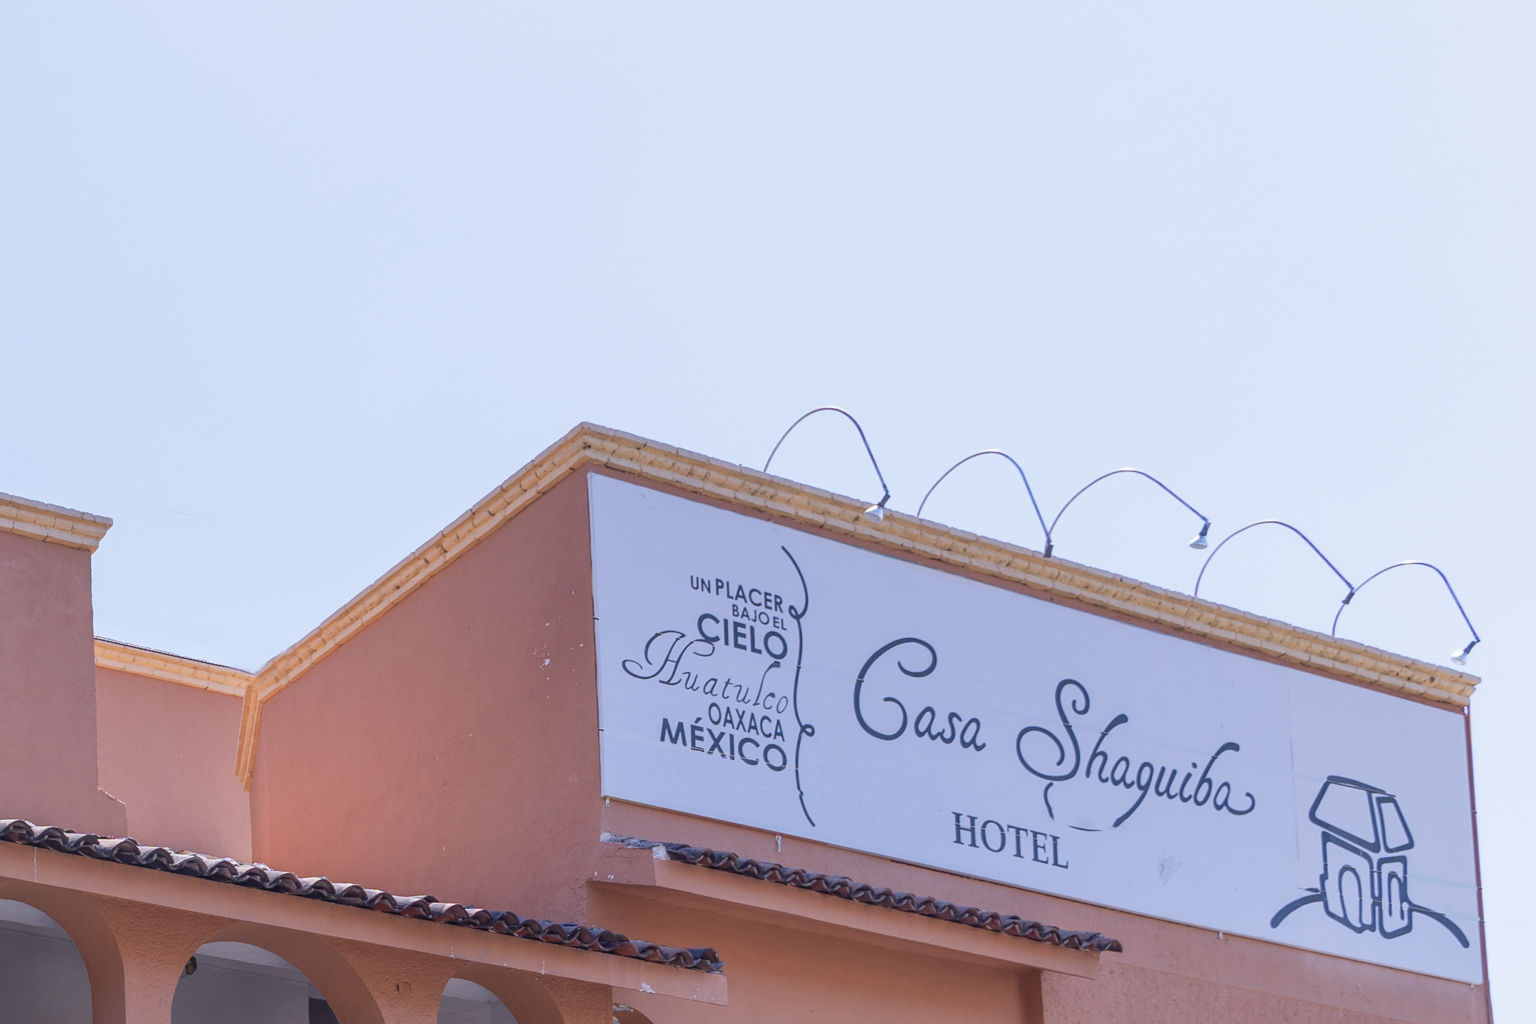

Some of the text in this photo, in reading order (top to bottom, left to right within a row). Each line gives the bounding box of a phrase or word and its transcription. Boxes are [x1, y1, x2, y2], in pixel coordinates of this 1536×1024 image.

[690, 575, 784, 613] UN PLACER
[731, 604, 788, 631] BAJO EL
[697, 613, 788, 660] CIELO
[622, 630, 789, 714] Huatulco
[660, 717, 787, 772] MÉXICO
[708, 702, 785, 742] OAXACA
[853, 637, 1255, 828] Casa Shaguiba
[951, 811, 1069, 869] HOTEL
